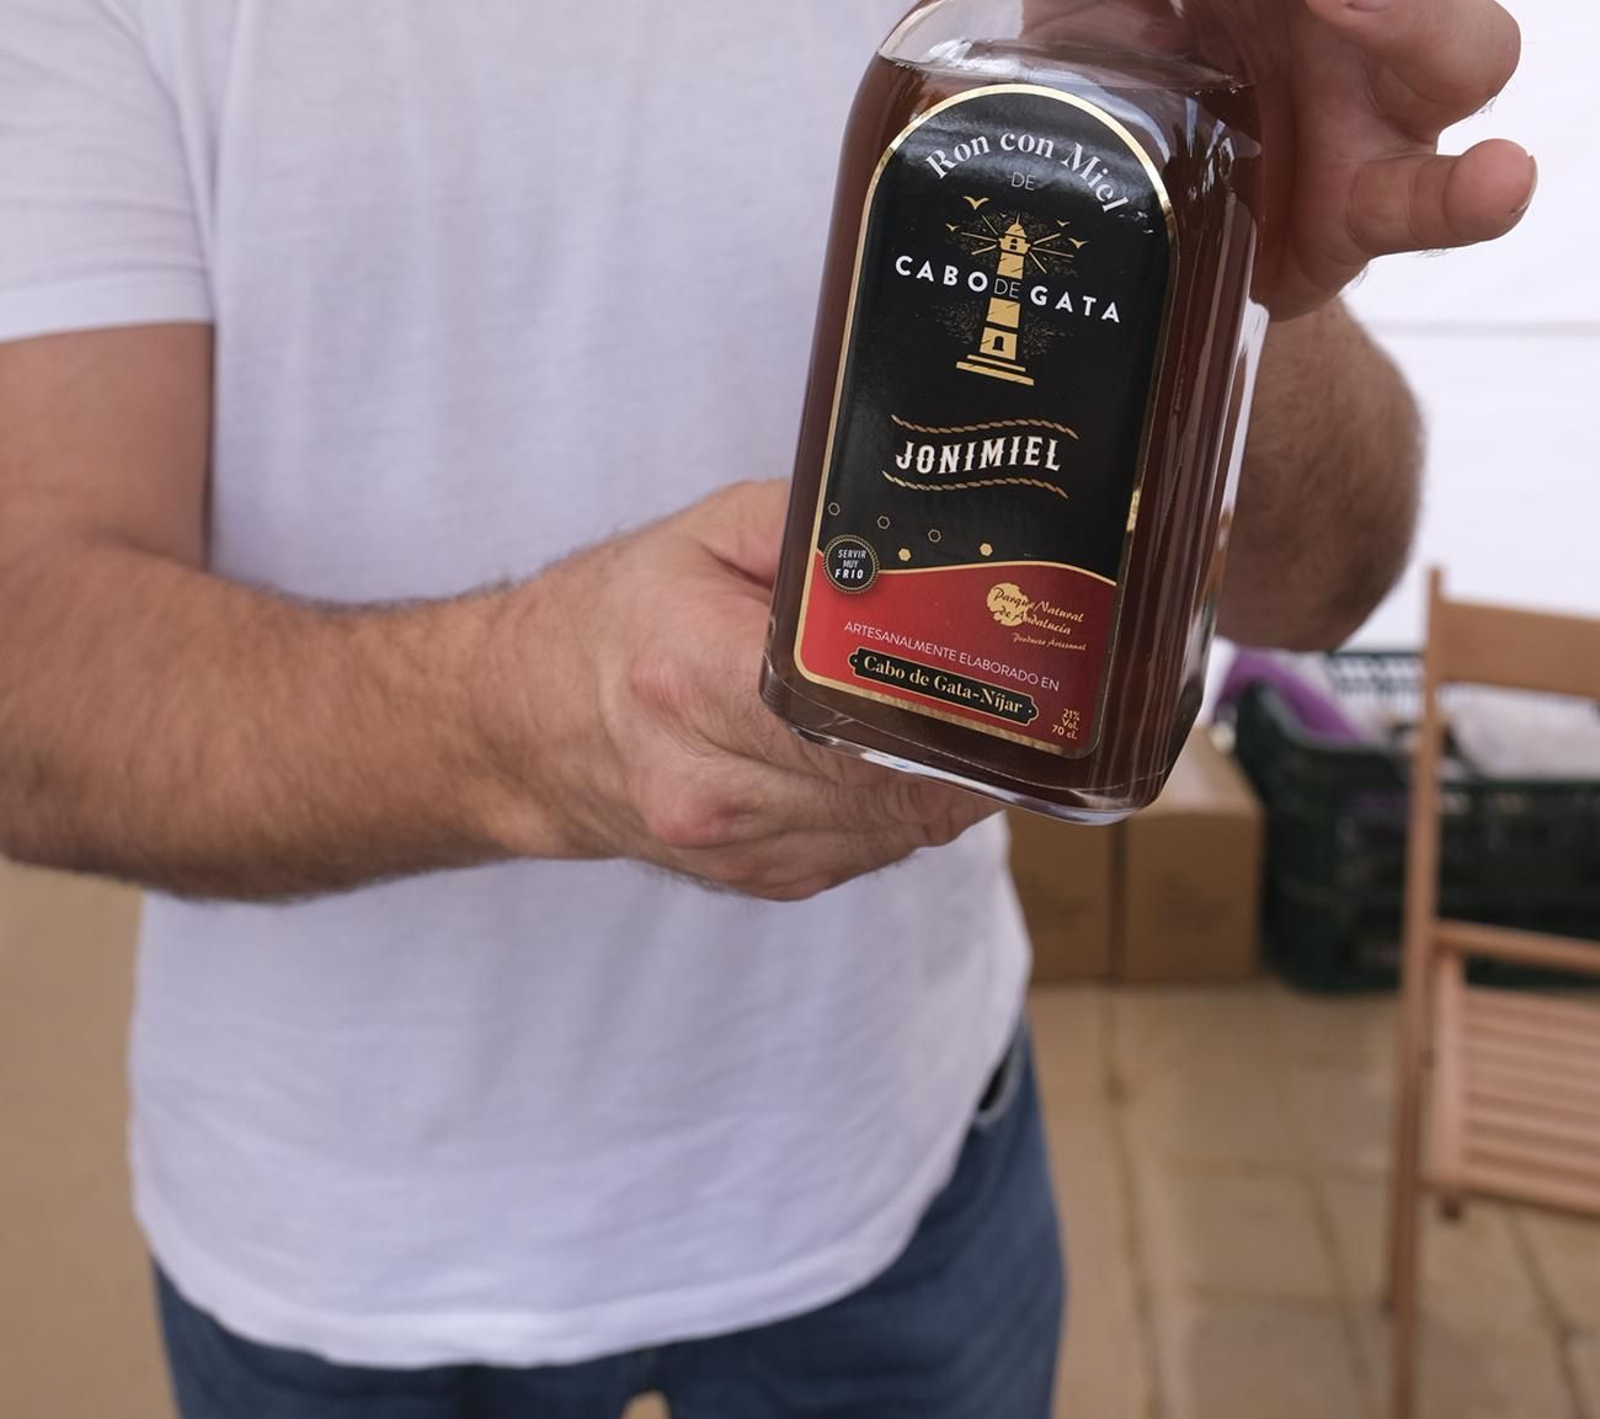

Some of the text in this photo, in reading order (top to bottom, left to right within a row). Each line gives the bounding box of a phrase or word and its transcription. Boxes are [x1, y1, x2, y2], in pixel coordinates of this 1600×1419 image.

[924, 132, 1130, 213] Ron con Miel
[1011, 172, 1036, 191] DE
[895, 255, 1121, 324] CABO DE GATA
[895, 435, 1062, 475] JONIMIEL
[838, 549, 867, 559] SERVIR
[835, 568, 864, 579] FRIO
[843, 559, 859, 569] MUY
[993, 586, 1085, 623] Parque Natural
[999, 605, 1010, 620] de
[843, 621, 1060, 692] ARTESANALMENTE ELABORADO EN
[864, 655, 906, 679] Cabo
[909, 669, 930, 686] de
[1063, 708, 1080, 721] 21%
[1052, 724, 1065, 736] 70
